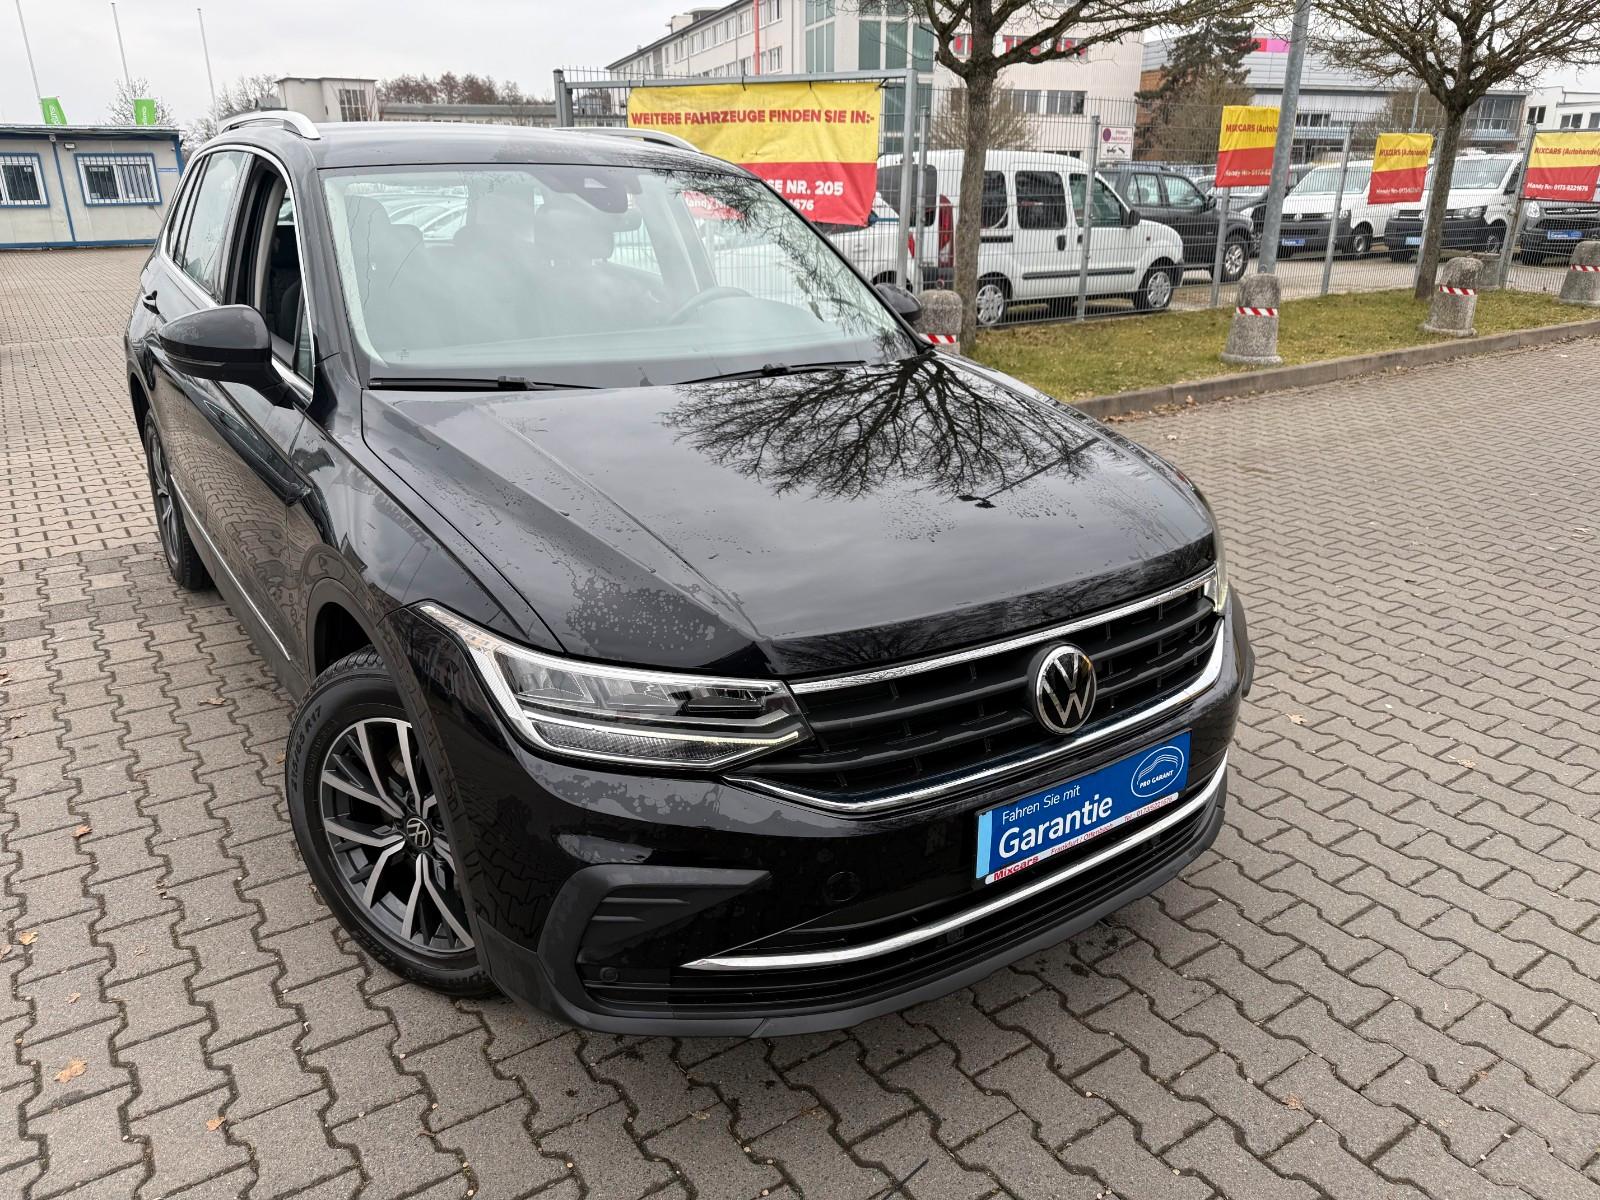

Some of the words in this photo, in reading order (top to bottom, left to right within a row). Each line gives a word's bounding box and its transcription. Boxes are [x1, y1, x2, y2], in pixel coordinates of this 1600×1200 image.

[631, 111, 681, 125] WEITERE
[684, 109, 766, 125] FAHRZEUGE
[769, 109, 822, 122] FINDEN
[824, 110, 847, 123] SIE
[786, 179, 811, 194] NR.
[815, 181, 844, 196] 205
[1139, 780, 1151, 789] PRO
[1151, 769, 1174, 784] GARANT
[1002, 802, 1040, 826] Fahren
[1043, 794, 1060, 808] Sie
[1063, 785, 1081, 801] mit
[998, 793, 1113, 859] Garantie
[993, 856, 1040, 881] Mixcars
